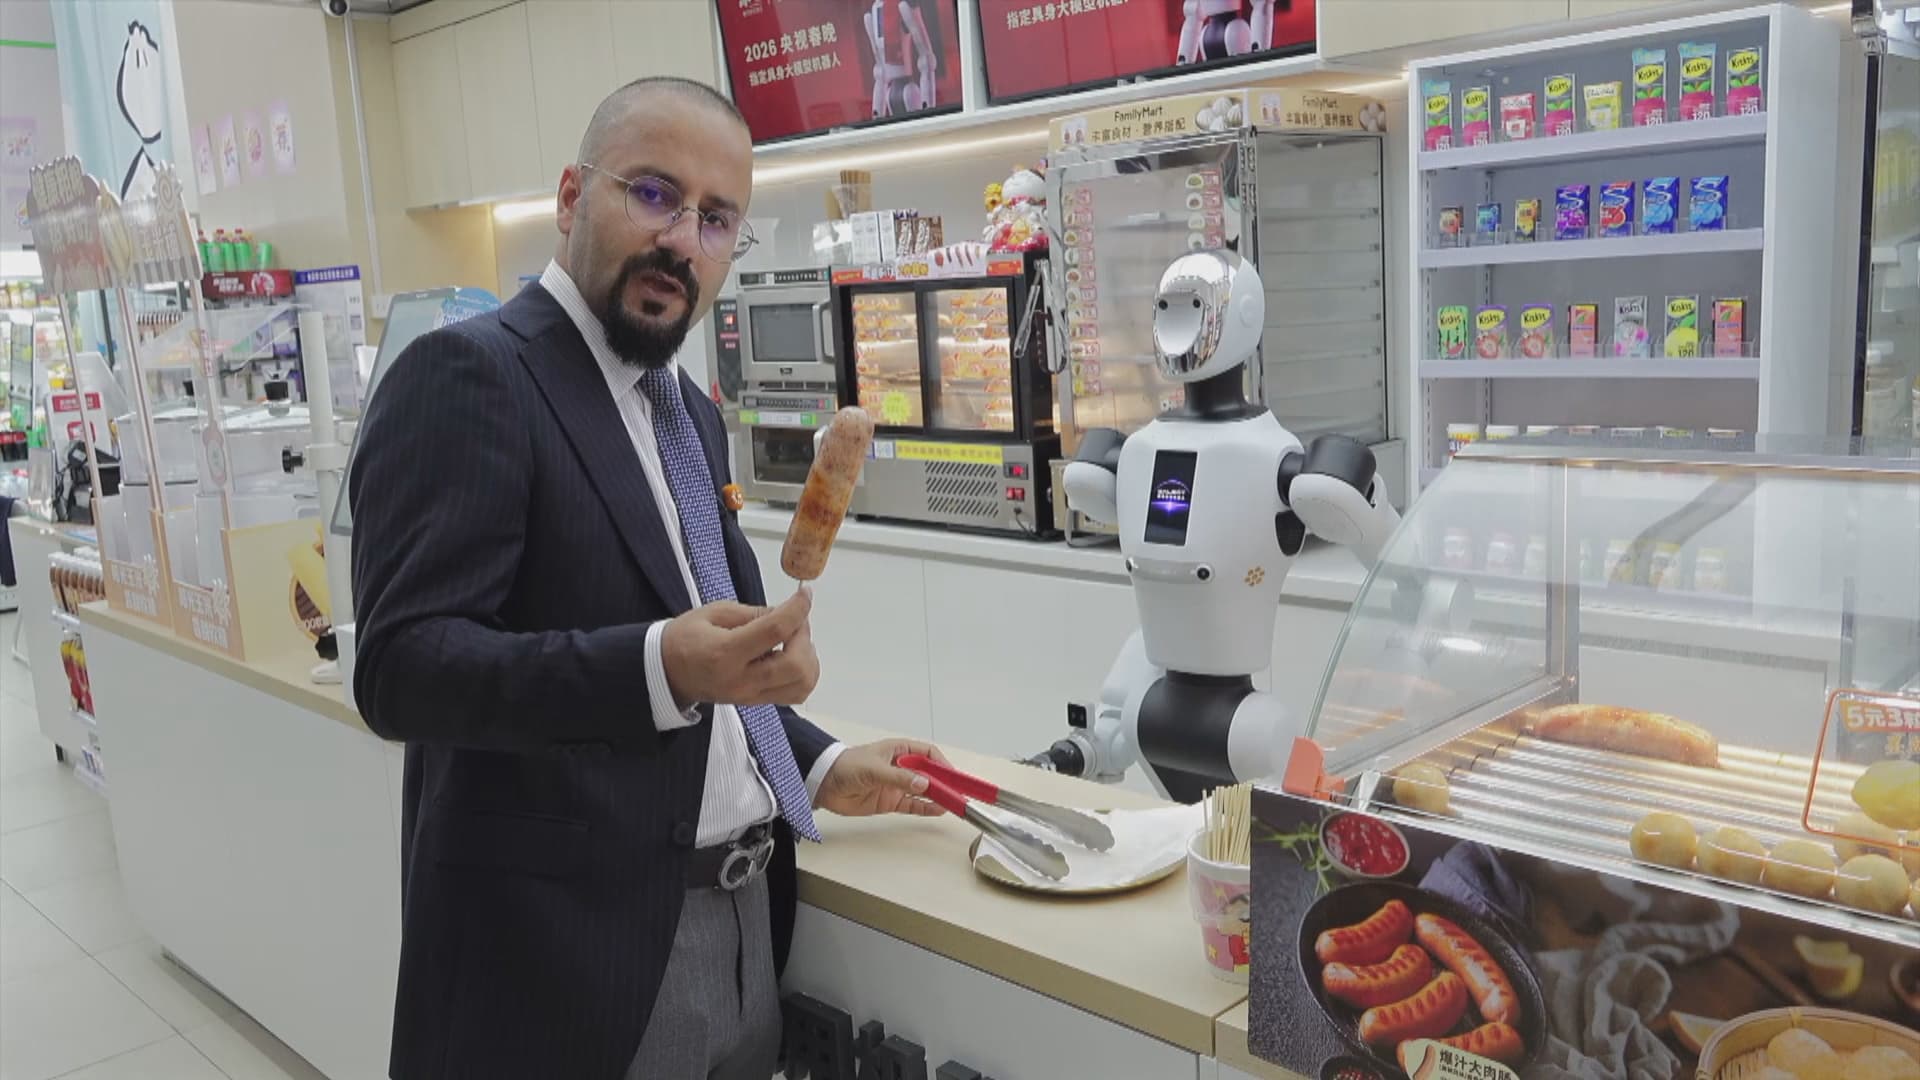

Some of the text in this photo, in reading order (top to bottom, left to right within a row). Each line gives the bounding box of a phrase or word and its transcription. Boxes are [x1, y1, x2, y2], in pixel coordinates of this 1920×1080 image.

[744, 22, 837, 62] 2026 央视春晚
[749, 52, 841, 86] 指定具身大模型机器人
[1114, 106, 1163, 122] FamilyMart
